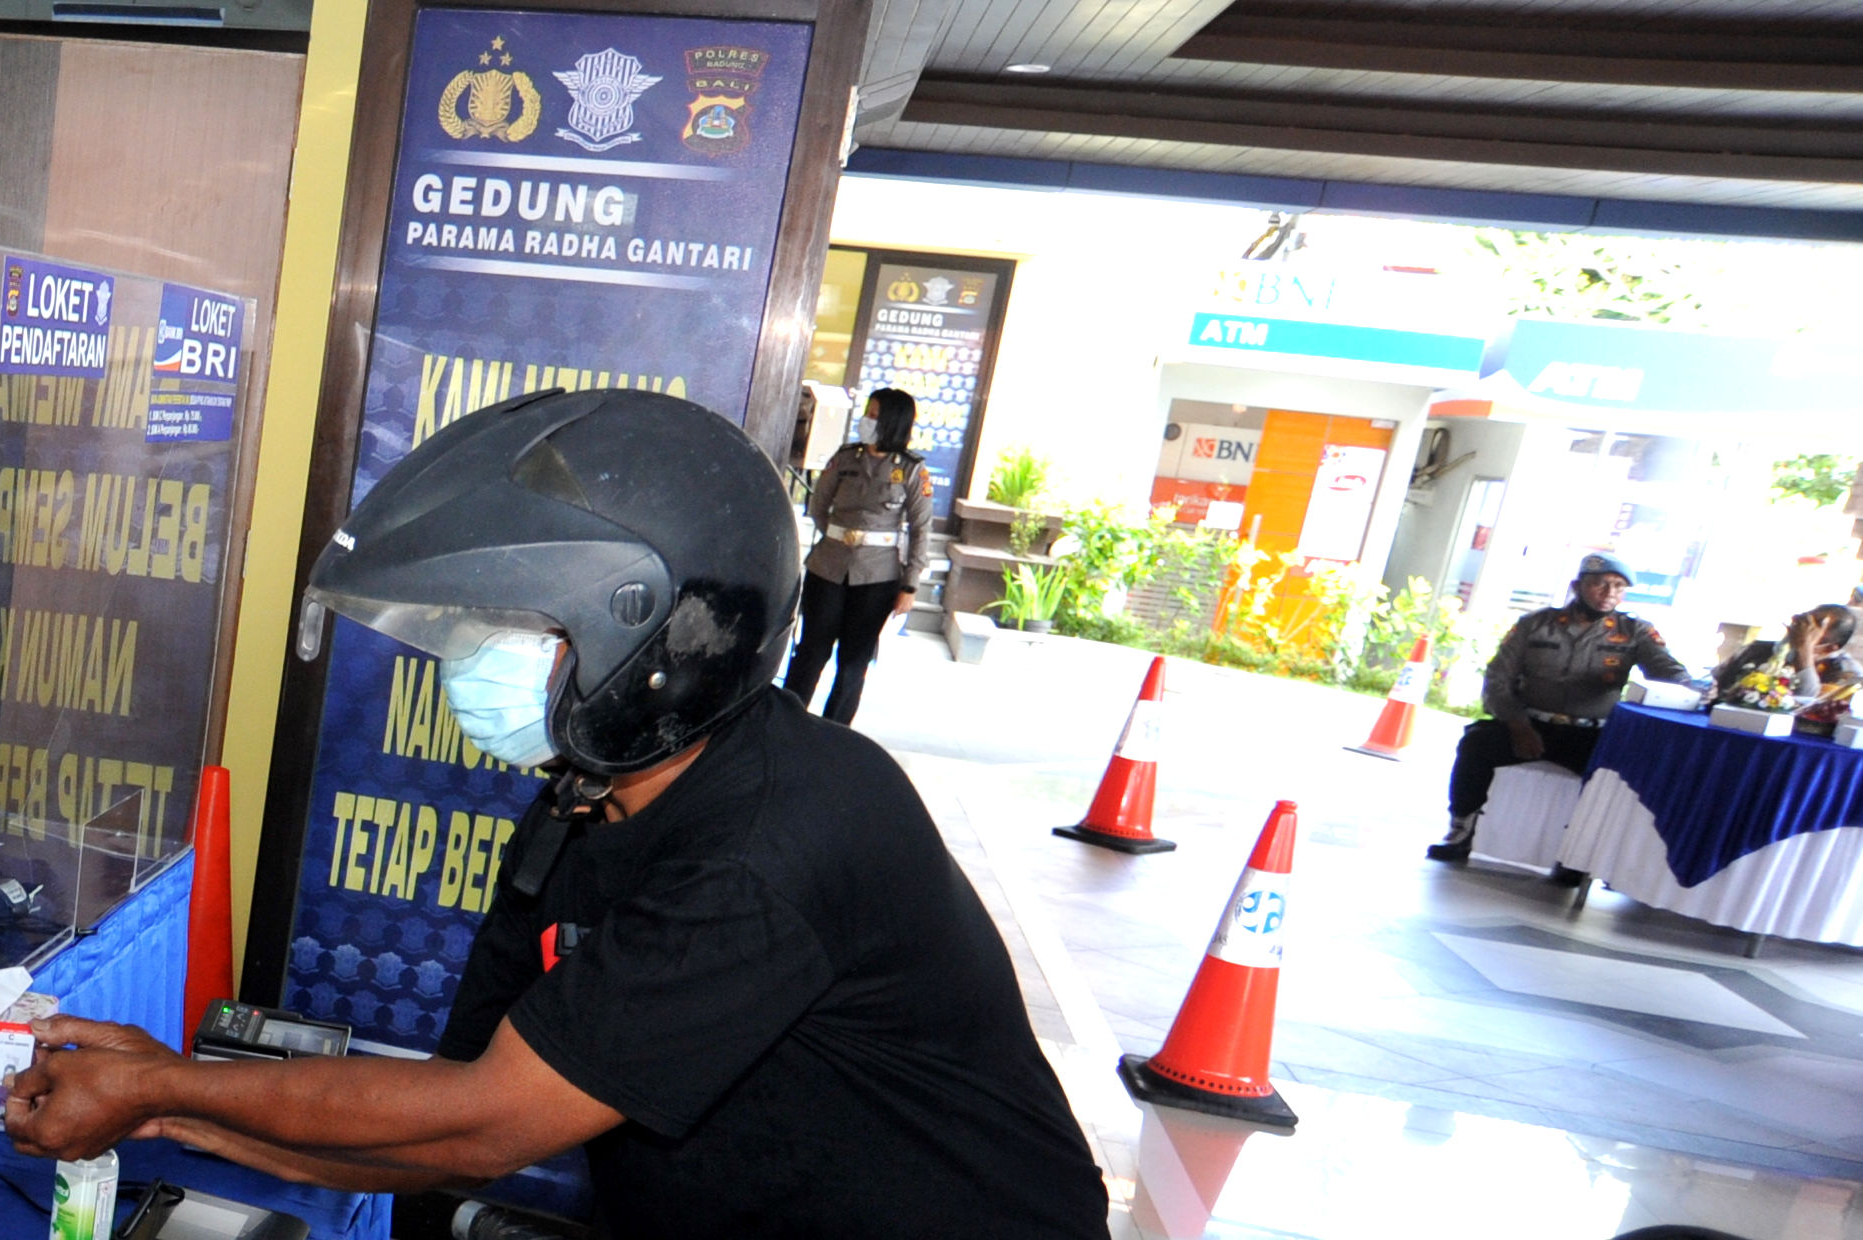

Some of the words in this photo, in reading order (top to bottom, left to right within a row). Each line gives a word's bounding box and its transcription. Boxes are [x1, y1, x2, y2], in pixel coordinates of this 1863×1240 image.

[694, 49, 760, 63] POLRES
[695, 80, 750, 92] BALI
[412, 173, 626, 227] GEDUNG
[406, 221, 515, 253] PARAMA
[523, 229, 618, 262] RADHA
[626, 237, 753, 272] GANTARI
[27, 272, 94, 324] LOKET
[190, 297, 236, 338] LOKET
[877, 308, 944, 327] GEDUNG
[0, 325, 107, 369] PENDAFTARAN
[1199, 318, 1270, 347] ATM
[179, 338, 237, 379] BRI
[1526, 359, 1645, 402] ATM
[329, 791, 439, 901] TETAP
